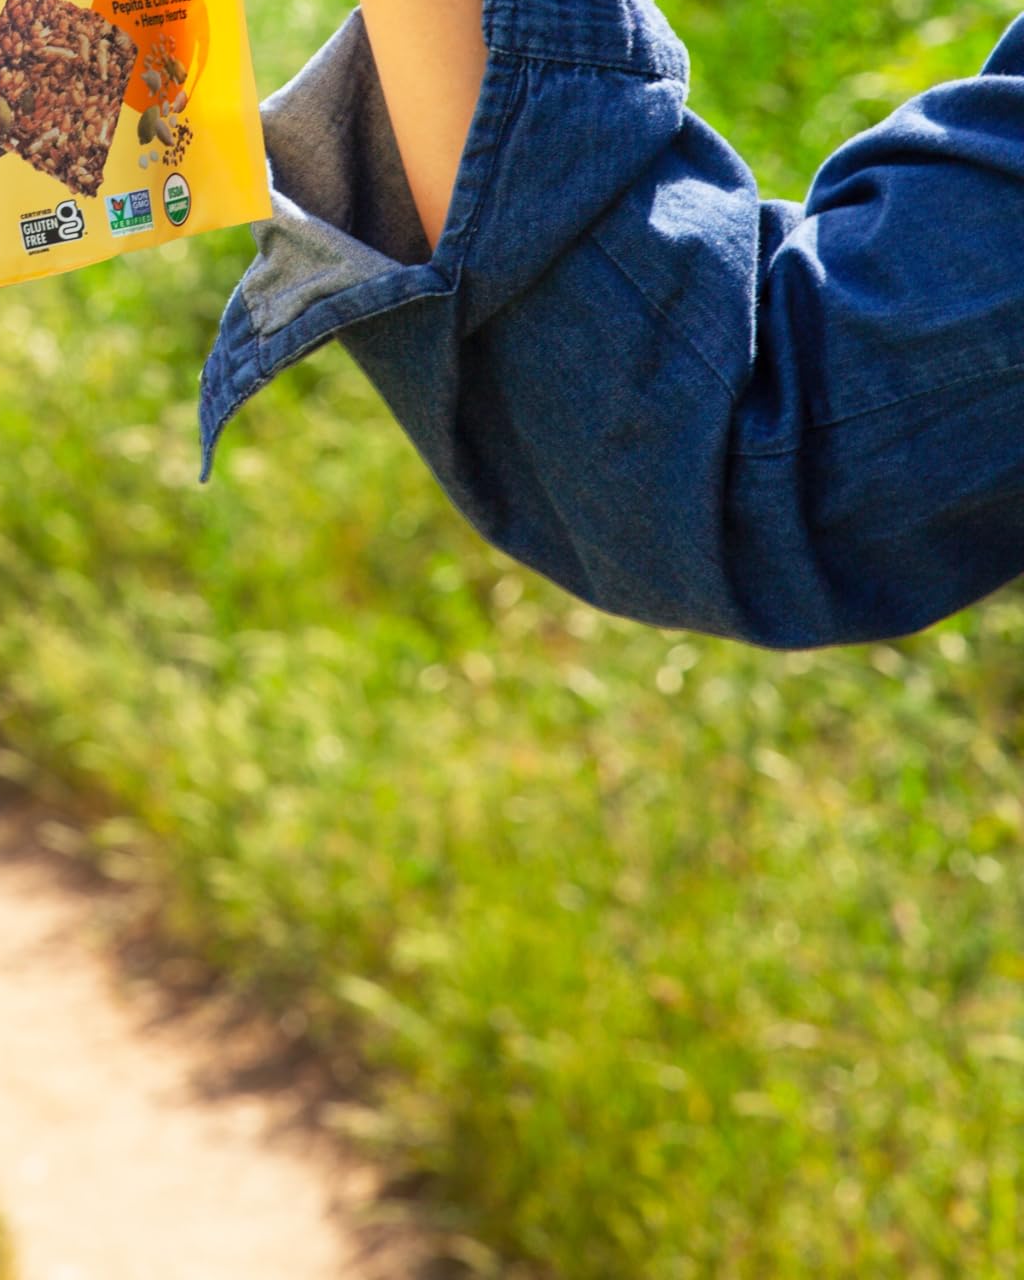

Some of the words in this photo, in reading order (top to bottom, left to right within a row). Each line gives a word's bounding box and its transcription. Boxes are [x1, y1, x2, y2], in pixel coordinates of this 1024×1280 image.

[131, 191, 148, 202] NON
[132, 200, 149, 209] GMO
[23, 217, 59, 235] GLUTEN
[25, 232, 48, 248] FREE
